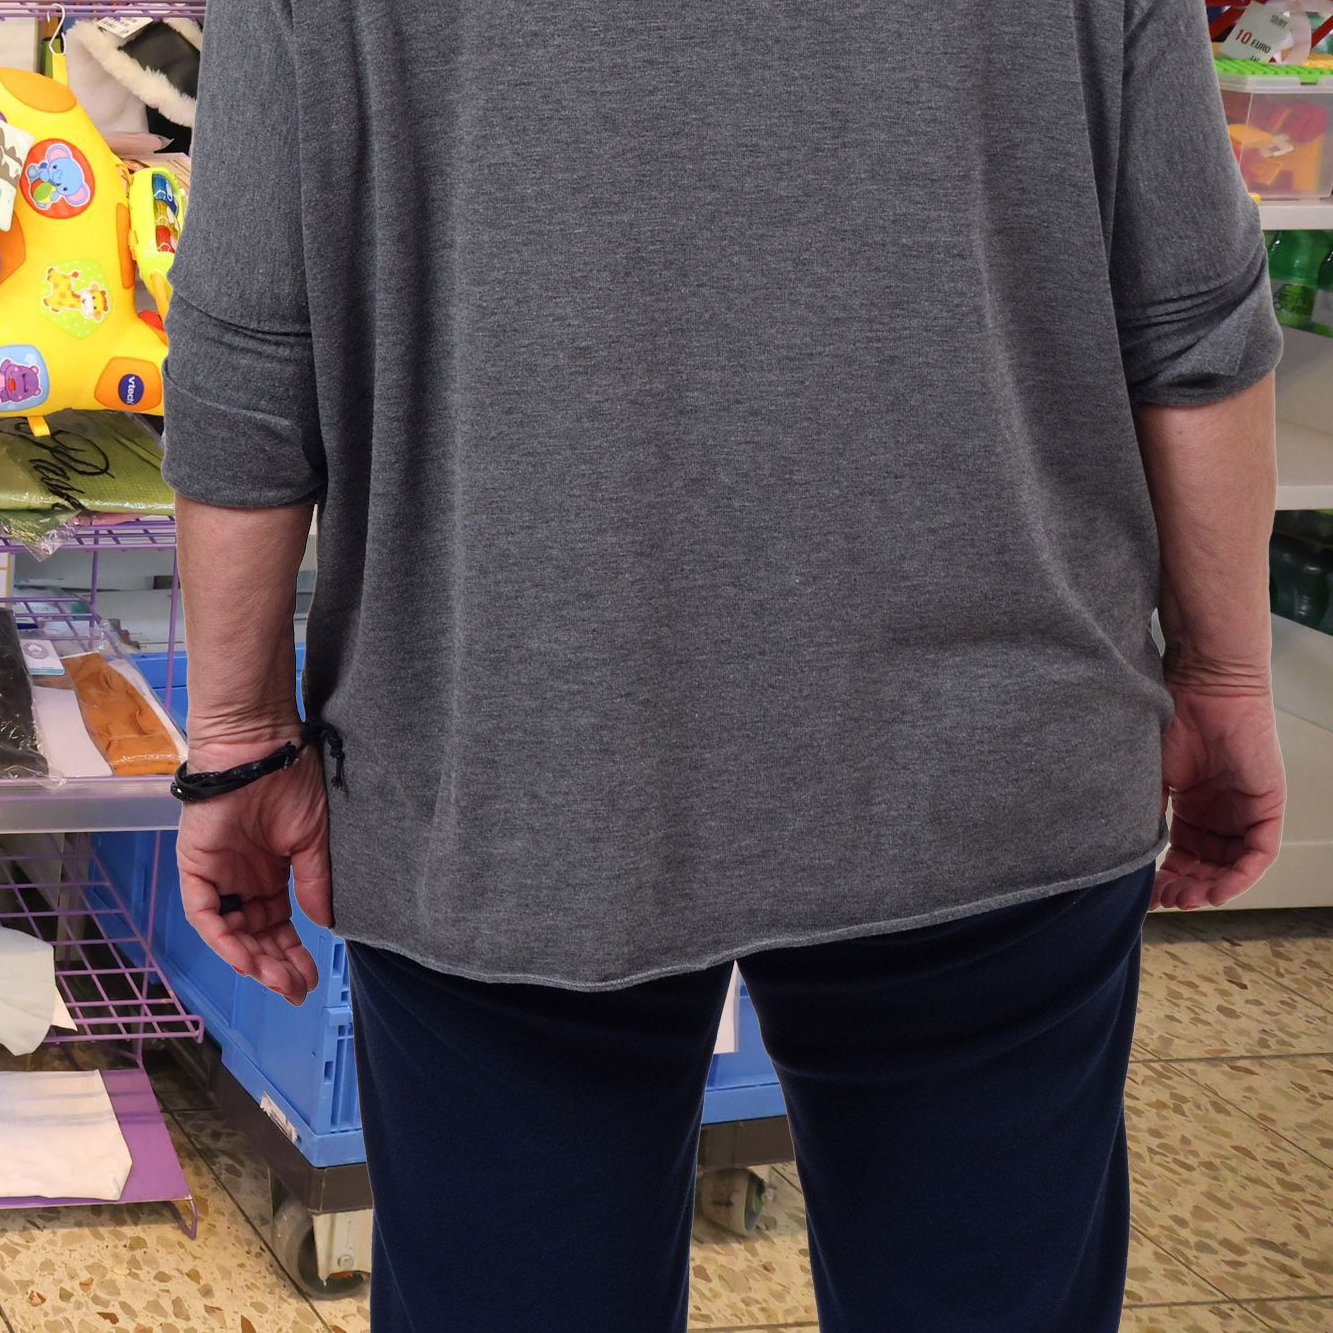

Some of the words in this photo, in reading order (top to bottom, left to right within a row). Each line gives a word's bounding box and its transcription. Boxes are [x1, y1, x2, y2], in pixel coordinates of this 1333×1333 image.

[1236, 29, 1252, 44] 10
[1251, 38, 1271, 54] EURO
[127, 376, 136, 404] vtech
